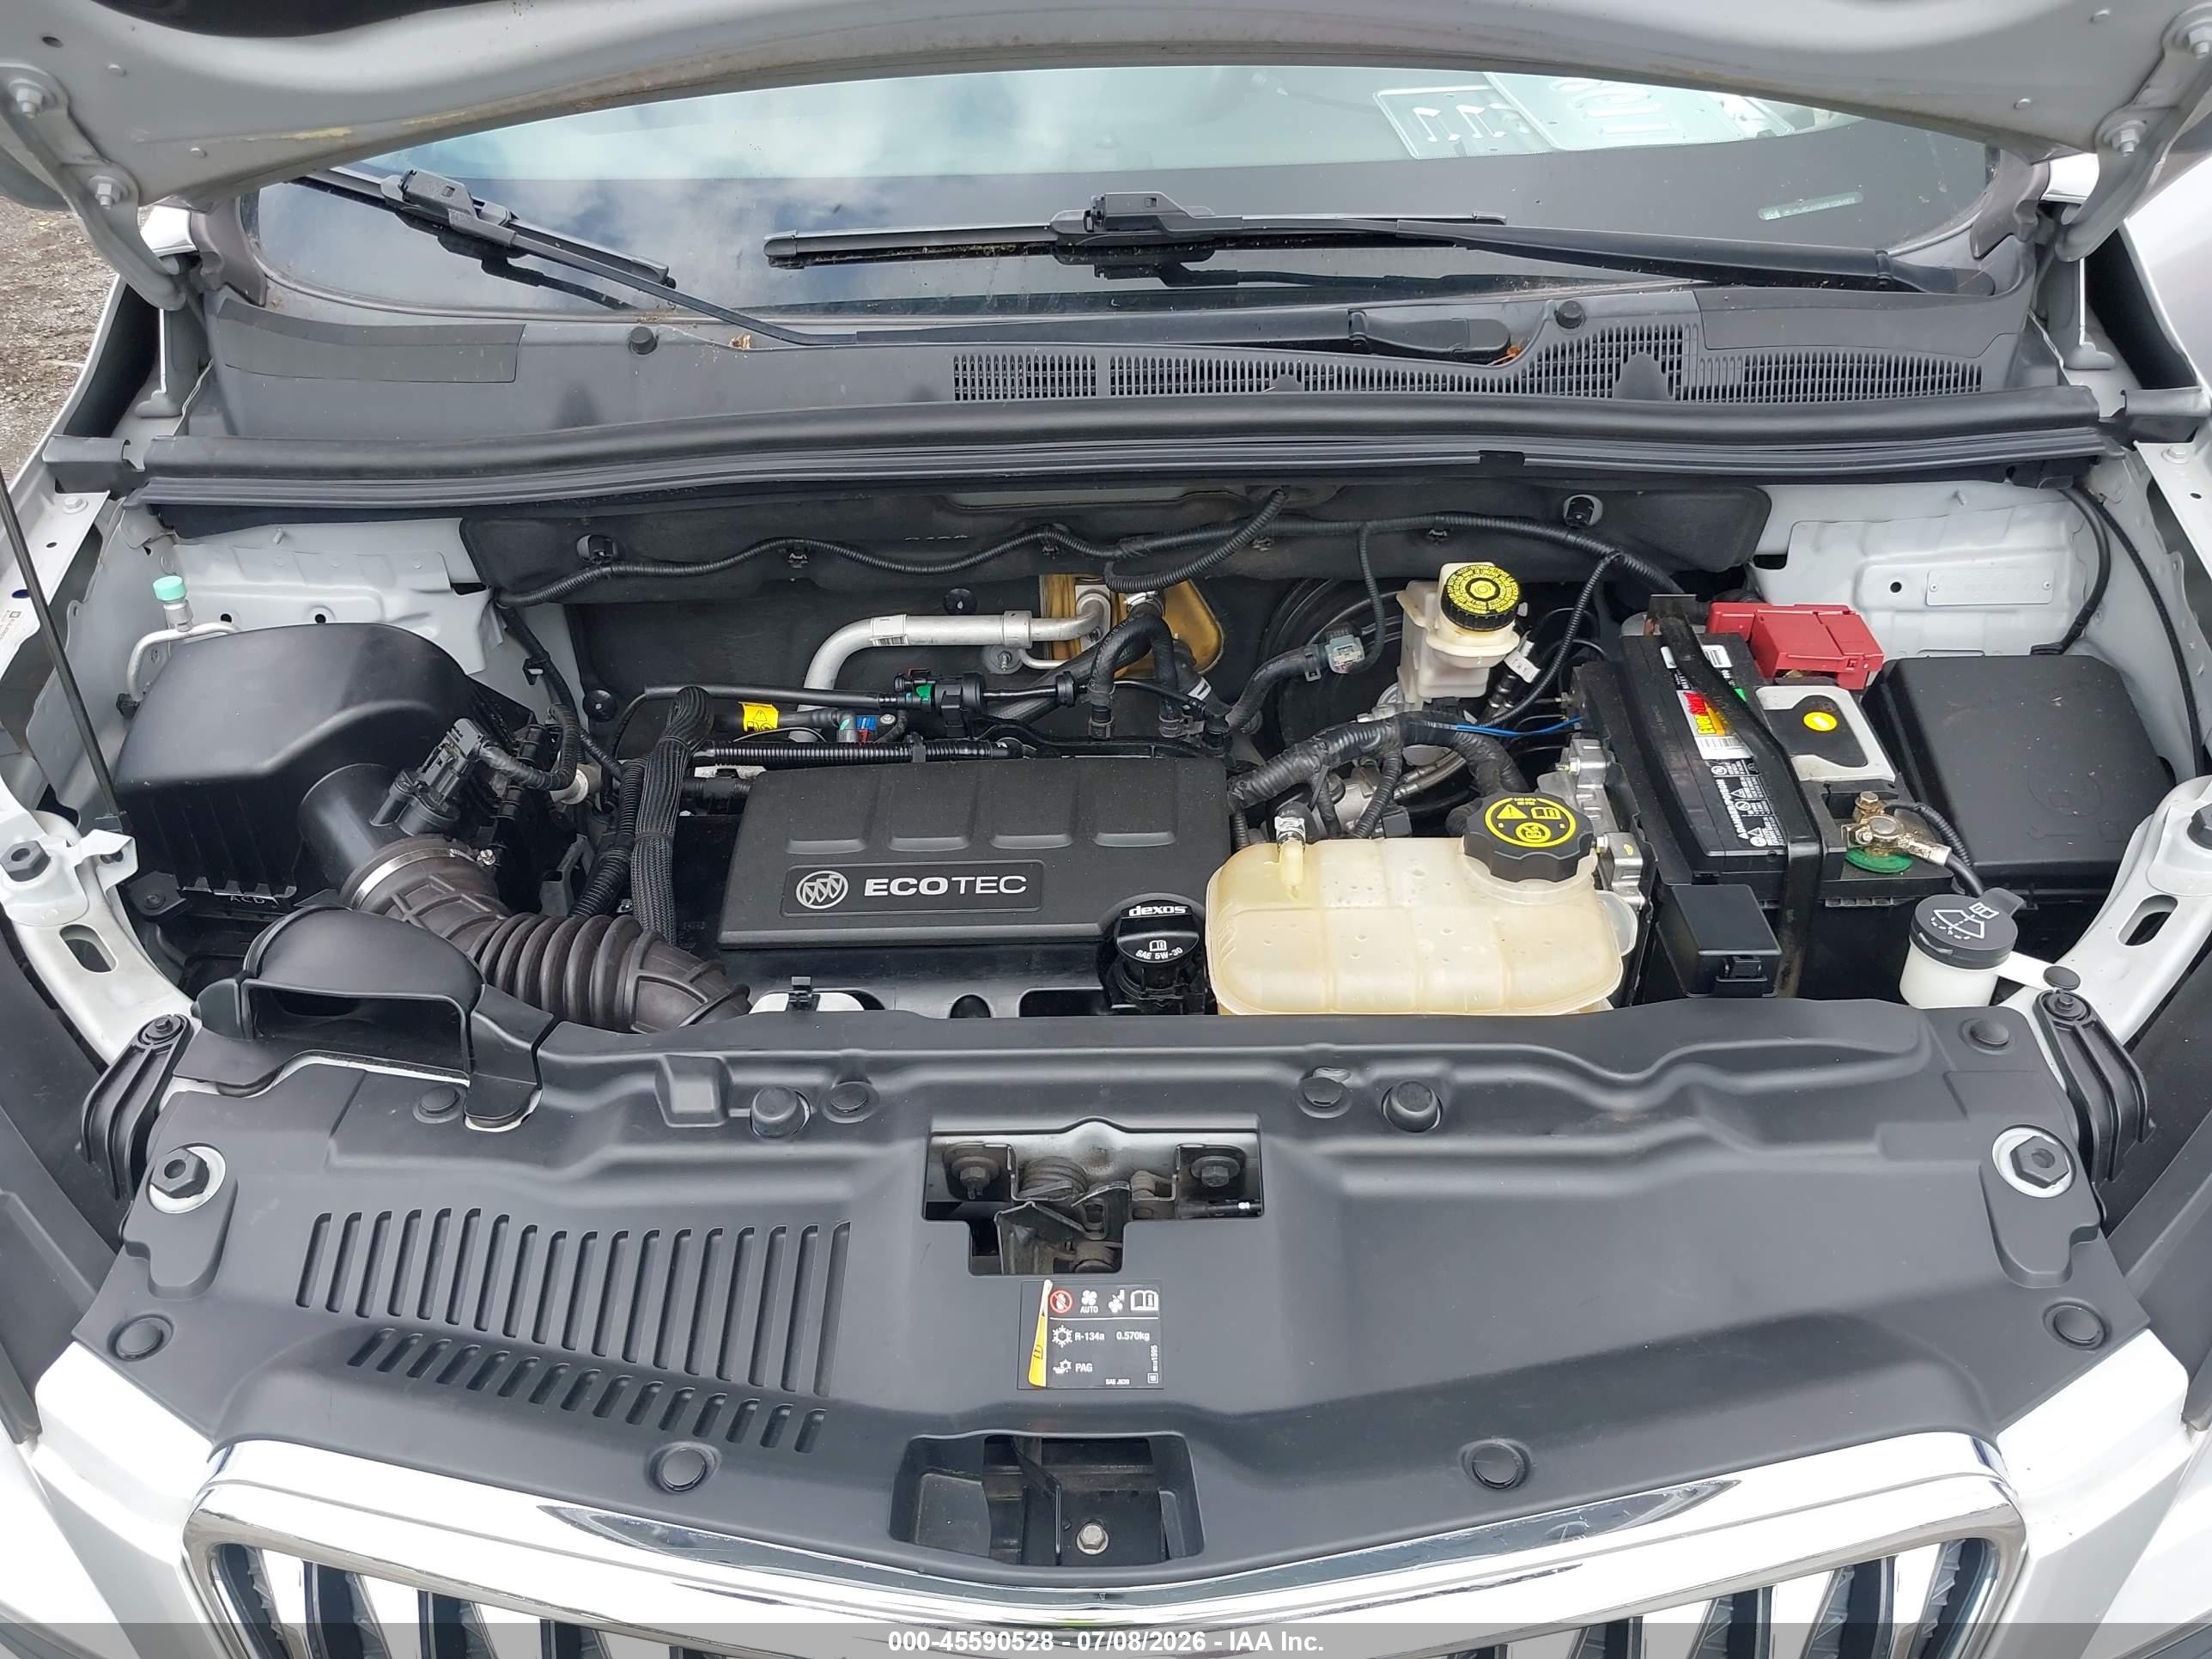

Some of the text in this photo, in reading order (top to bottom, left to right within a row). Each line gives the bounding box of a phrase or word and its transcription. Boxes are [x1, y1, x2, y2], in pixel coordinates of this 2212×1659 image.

[864, 874, 1027, 898] ECOTEC
[1128, 905, 1188, 917] dexos
[1135, 946, 1183, 960] SAE 5W-30
[1079, 1305, 1099, 1314] AUTO
[1074, 1330, 1151, 1342] R-134a 0.570kg
[1075, 1363, 1093, 1373] PAG
